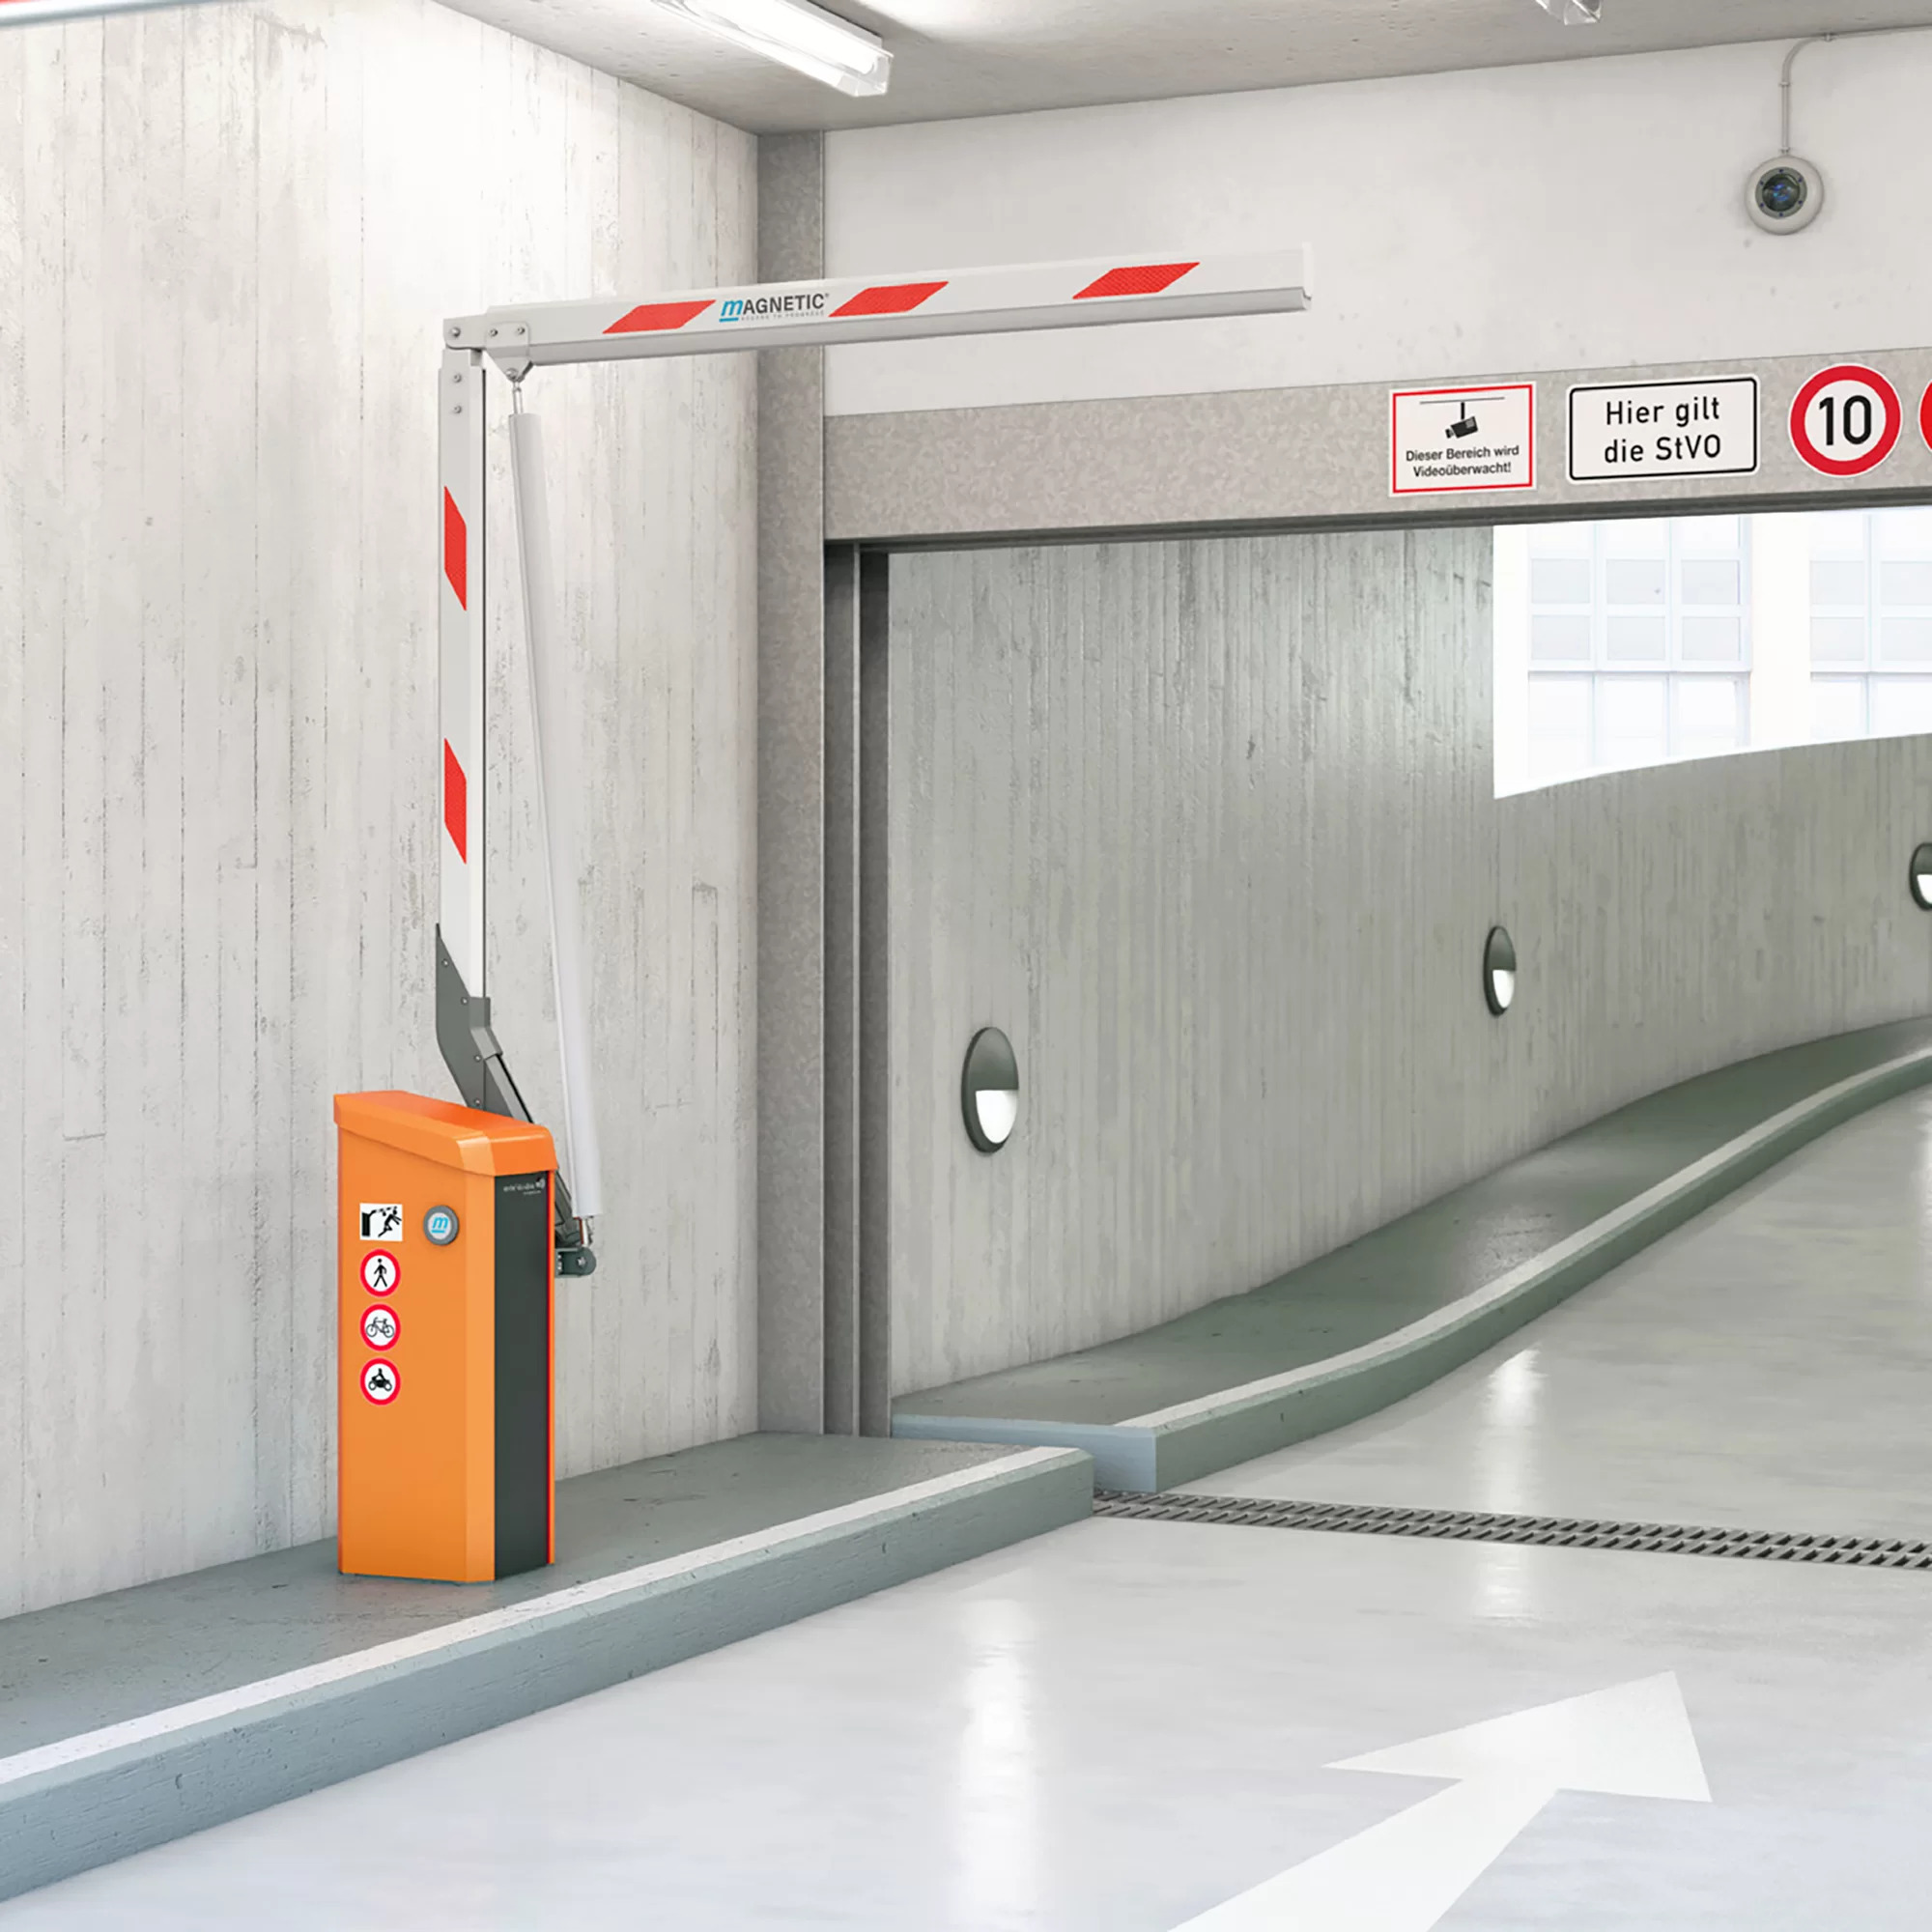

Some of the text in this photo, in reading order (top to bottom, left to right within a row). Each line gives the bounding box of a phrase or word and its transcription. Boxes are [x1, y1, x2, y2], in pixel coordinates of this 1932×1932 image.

[1606, 395, 1719, 428] Hier gilt
[1819, 394, 1872, 446] 10
[1406, 445, 1520, 462] Dieser Bereich wird
[1605, 434, 1720, 464] die StVO
[1413, 462, 1511, 477] Videoüberwacht!
